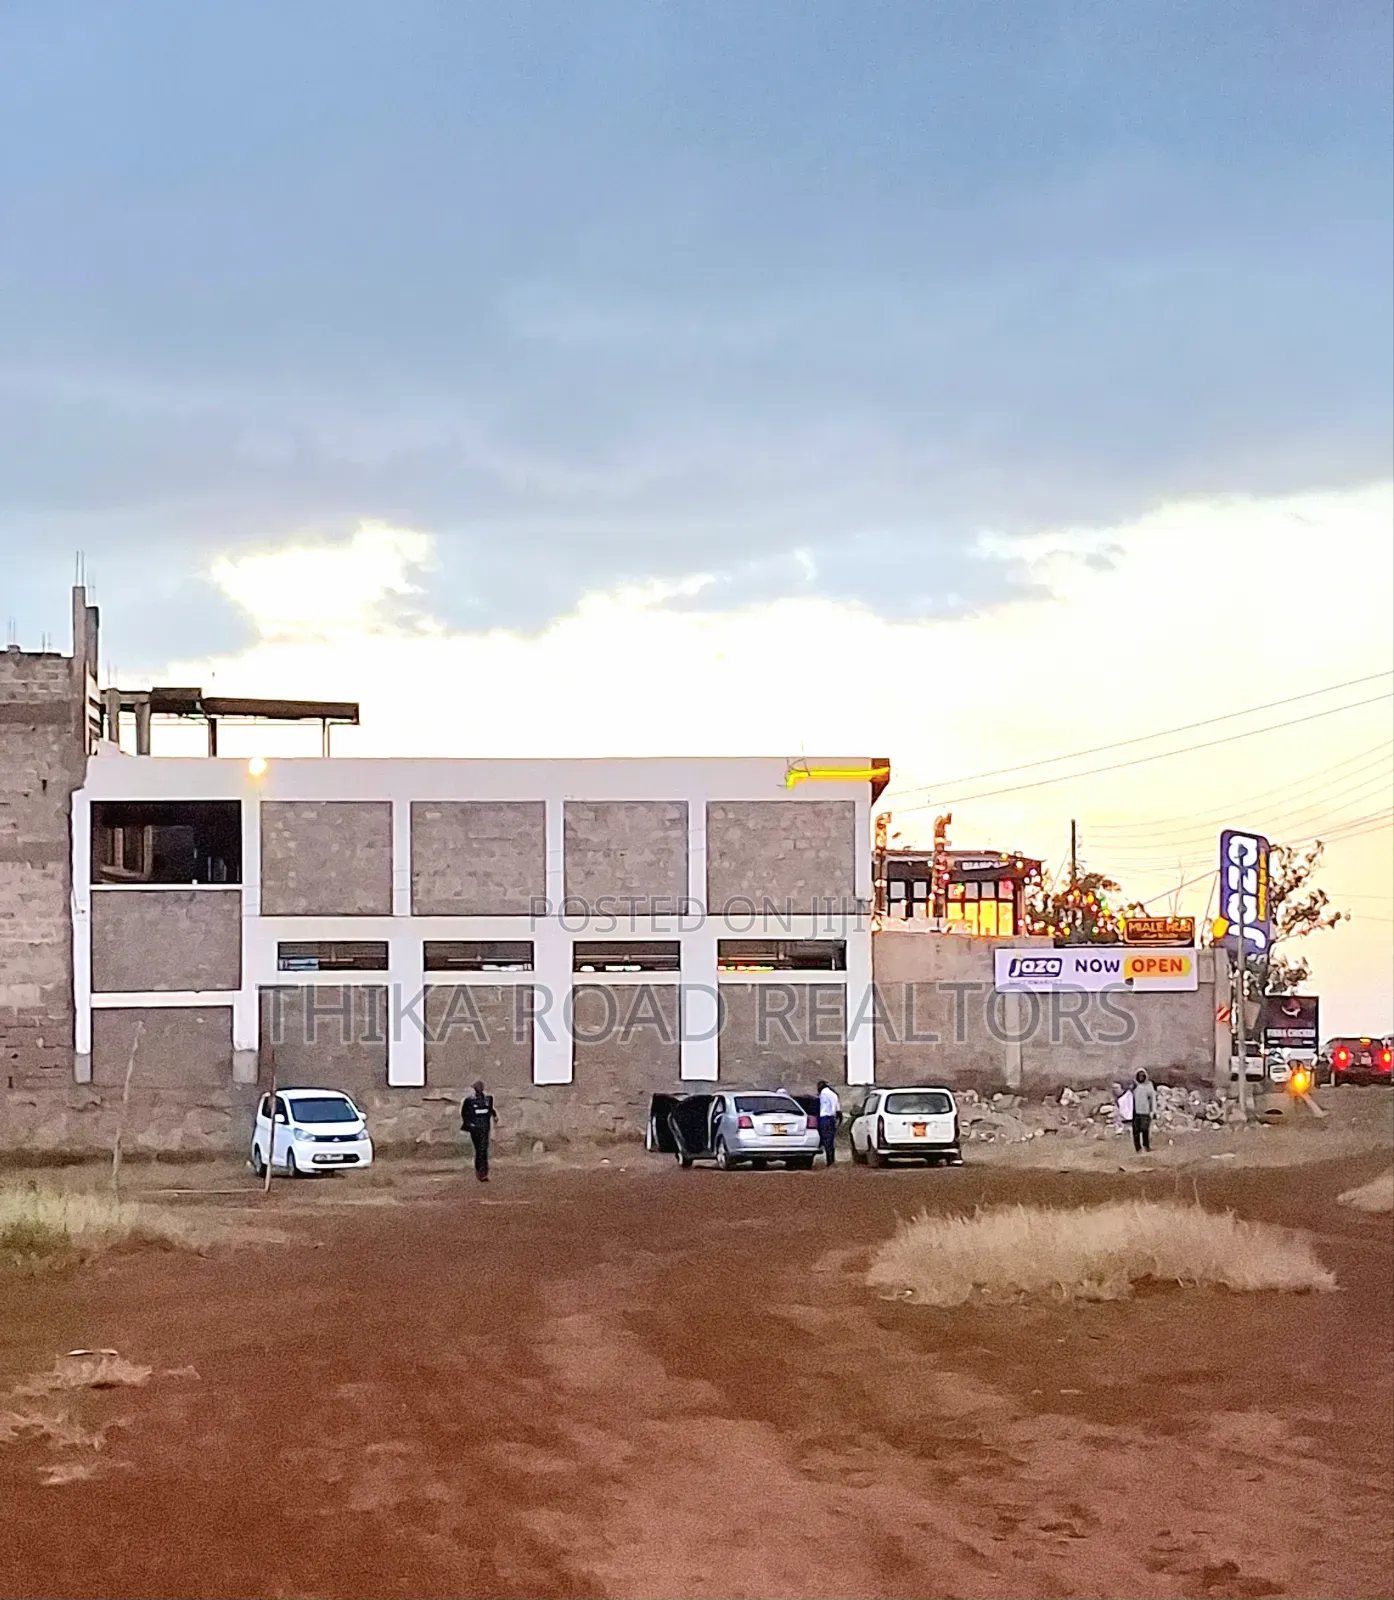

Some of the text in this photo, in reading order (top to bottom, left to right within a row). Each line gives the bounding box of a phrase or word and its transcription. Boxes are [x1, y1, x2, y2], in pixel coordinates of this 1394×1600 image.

[1227, 836, 1267, 949] jaza
[1010, 956, 1182, 977] jaza NOW OPEN
